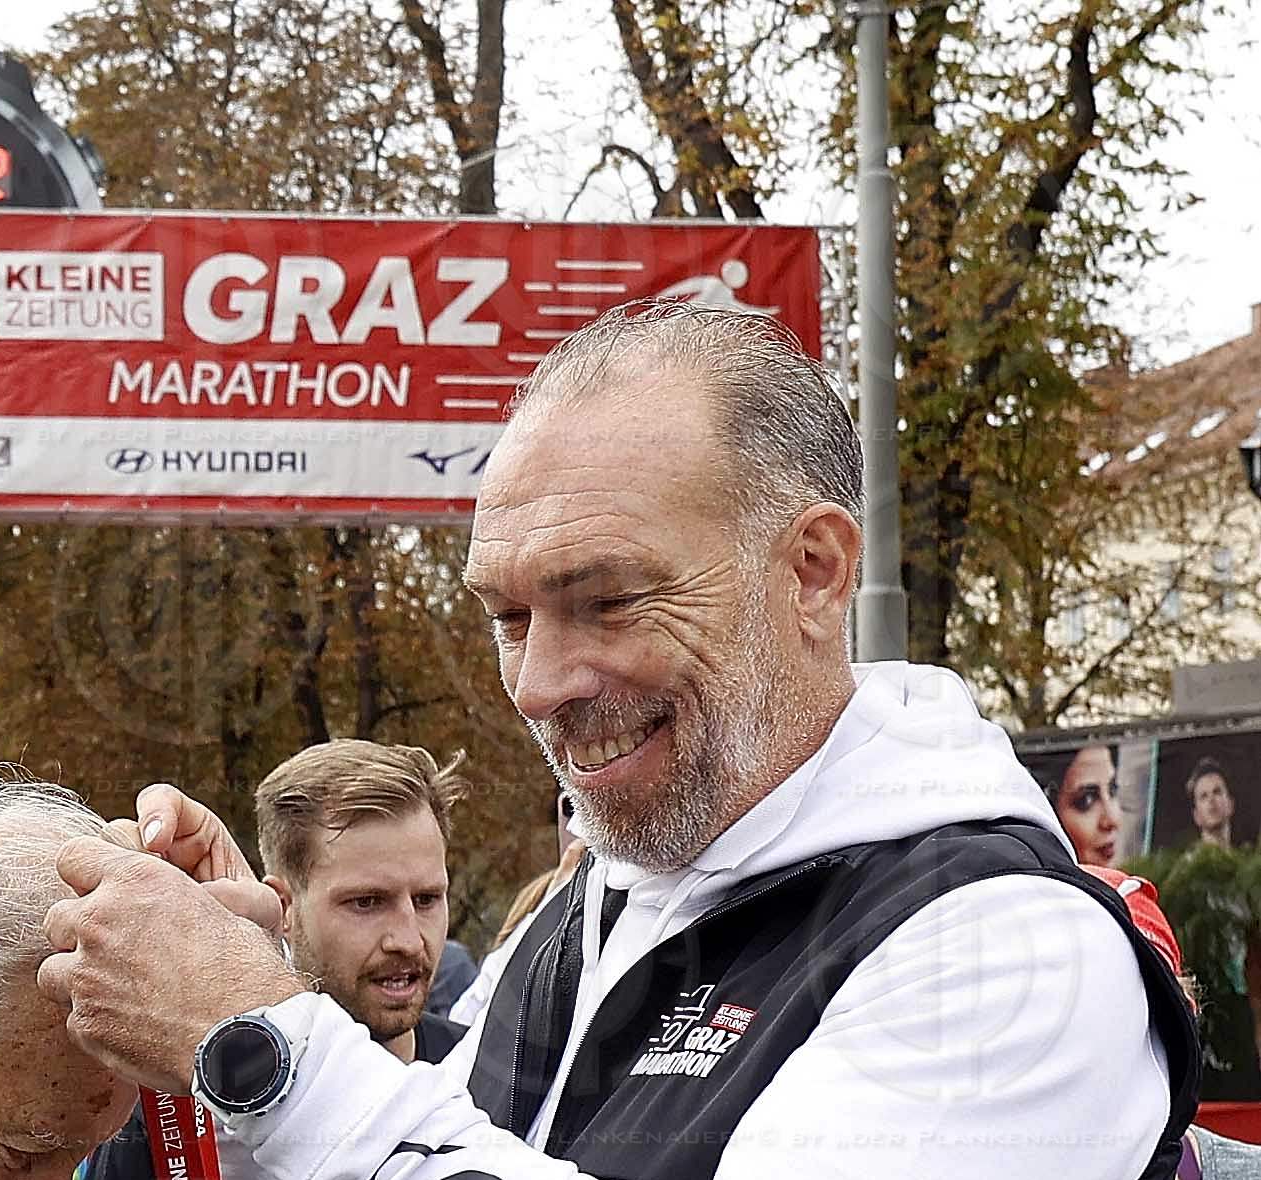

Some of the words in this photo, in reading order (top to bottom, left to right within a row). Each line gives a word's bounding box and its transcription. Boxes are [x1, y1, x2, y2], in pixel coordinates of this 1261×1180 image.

[5, 264, 151, 294] KLEINE
[5, 299, 153, 329] ZEITUNG
[183, 254, 510, 348] GRAZ
[108, 358, 411, 408] MARATHON
[162, 451, 307, 473] HYUNDAI
[684, 1026, 742, 1054] GRAZ
[629, 1051, 722, 1078] MARATHON
